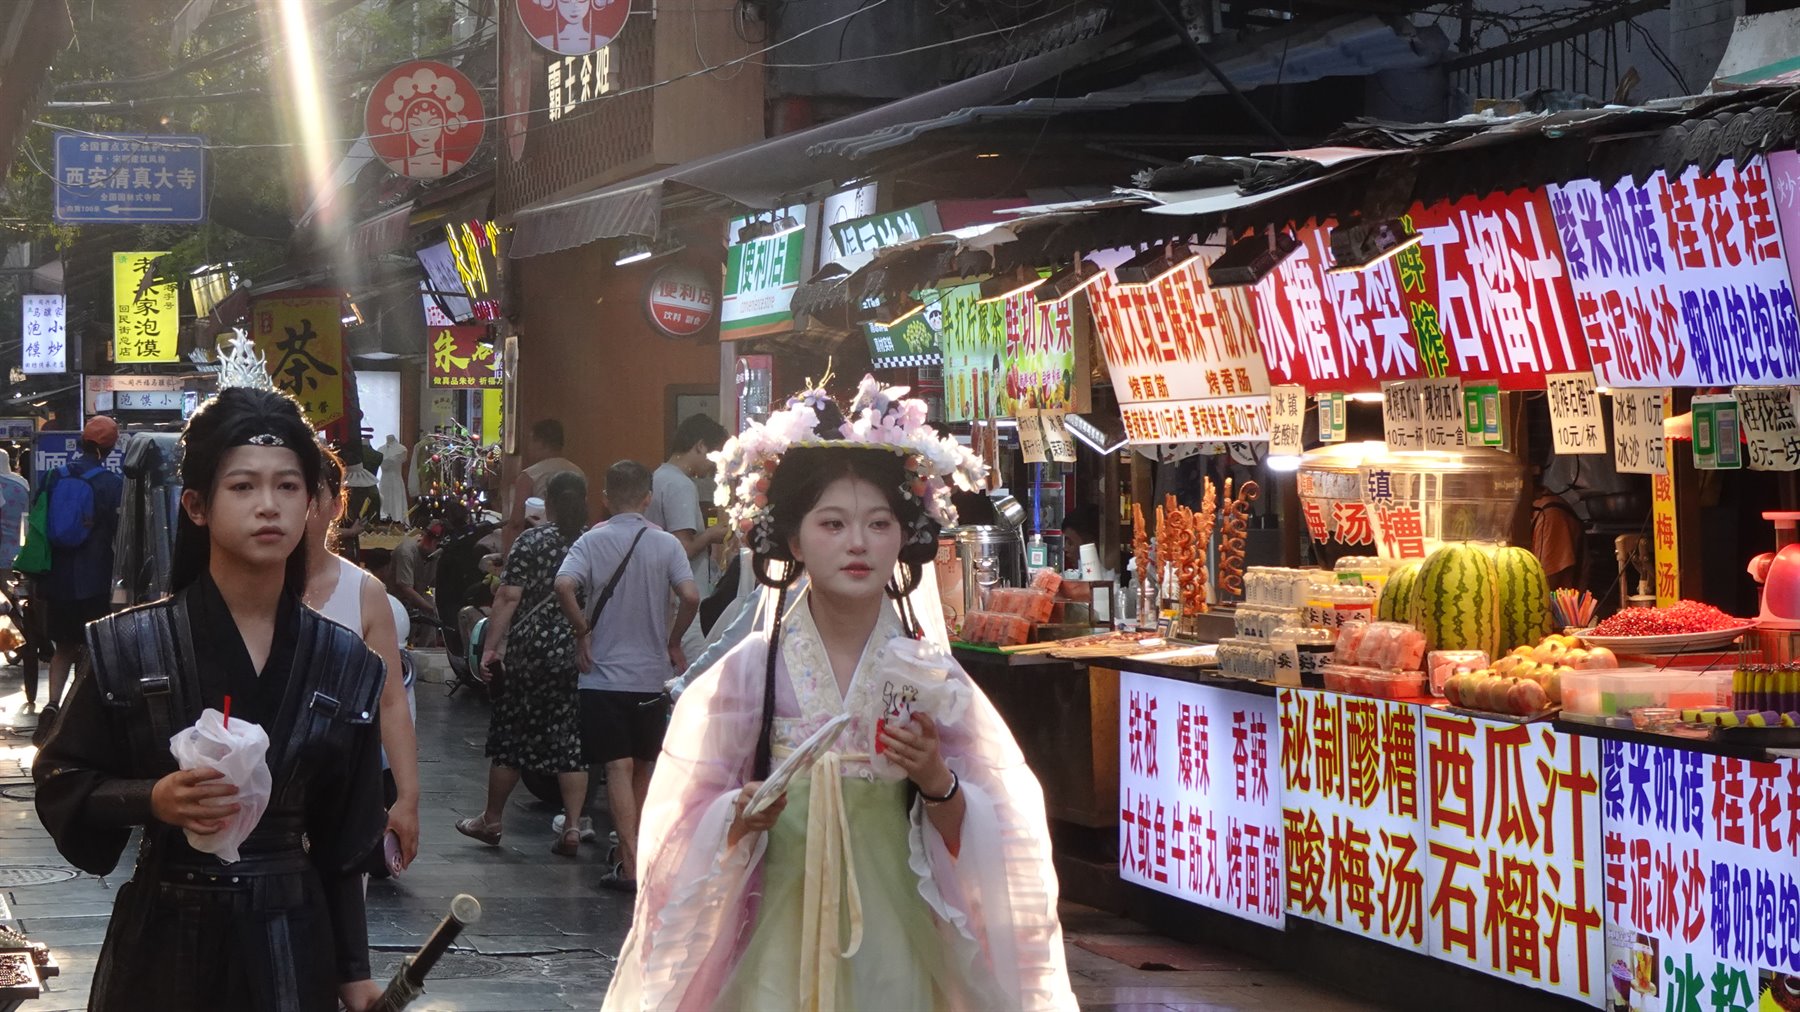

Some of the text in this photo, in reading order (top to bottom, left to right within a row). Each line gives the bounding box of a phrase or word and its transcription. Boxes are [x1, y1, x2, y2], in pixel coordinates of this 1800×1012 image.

[65, 167, 196, 189] 西安清真大寺
[1553, 186, 1666, 281] 紫米奶砖
[1657, 164, 1782, 271] 桂花糕
[658, 280, 713, 305] 便利店
[737, 234, 789, 295] 便利店
[1398, 214, 1450, 379] 鲜榨
[1418, 201, 1576, 374] 石榴汁
[272, 319, 338, 396] 茶
[1005, 288, 1072, 361] 鲜切水果
[1577, 284, 1686, 385] 芋泥冰沙
[1128, 368, 1252, 399] 烤面筋 烤香肠
[1274, 393, 1298, 416] 冰镇
[1423, 383, 1462, 421] 现切西瓜
[1615, 393, 1662, 426] 冰粉 10元
[1272, 423, 1299, 447] 老酸奶
[1386, 427, 1423, 447] 10元一杯
[1425, 426, 1465, 447] 10元一盒
[1558, 425, 1598, 447] 10元/杯
[1617, 434, 1665, 468] 冰沙 15元
[1750, 436, 1800, 466] 3元一块
[1368, 469, 1393, 505] 镇
[1129, 690, 1268, 806] 铁板 爆辣 香辣
[1279, 690, 1418, 821] 秘制醪糟
[1424, 714, 1598, 863] 西瓜汁
[1603, 739, 1704, 840] 紫米奶砖
[1226, 815, 1280, 920] 烤面筋
[1282, 808, 1425, 946] 酸梅汤
[1605, 831, 1706, 944] 芋泥冰沙
[1428, 840, 1602, 997] 石榴汁
